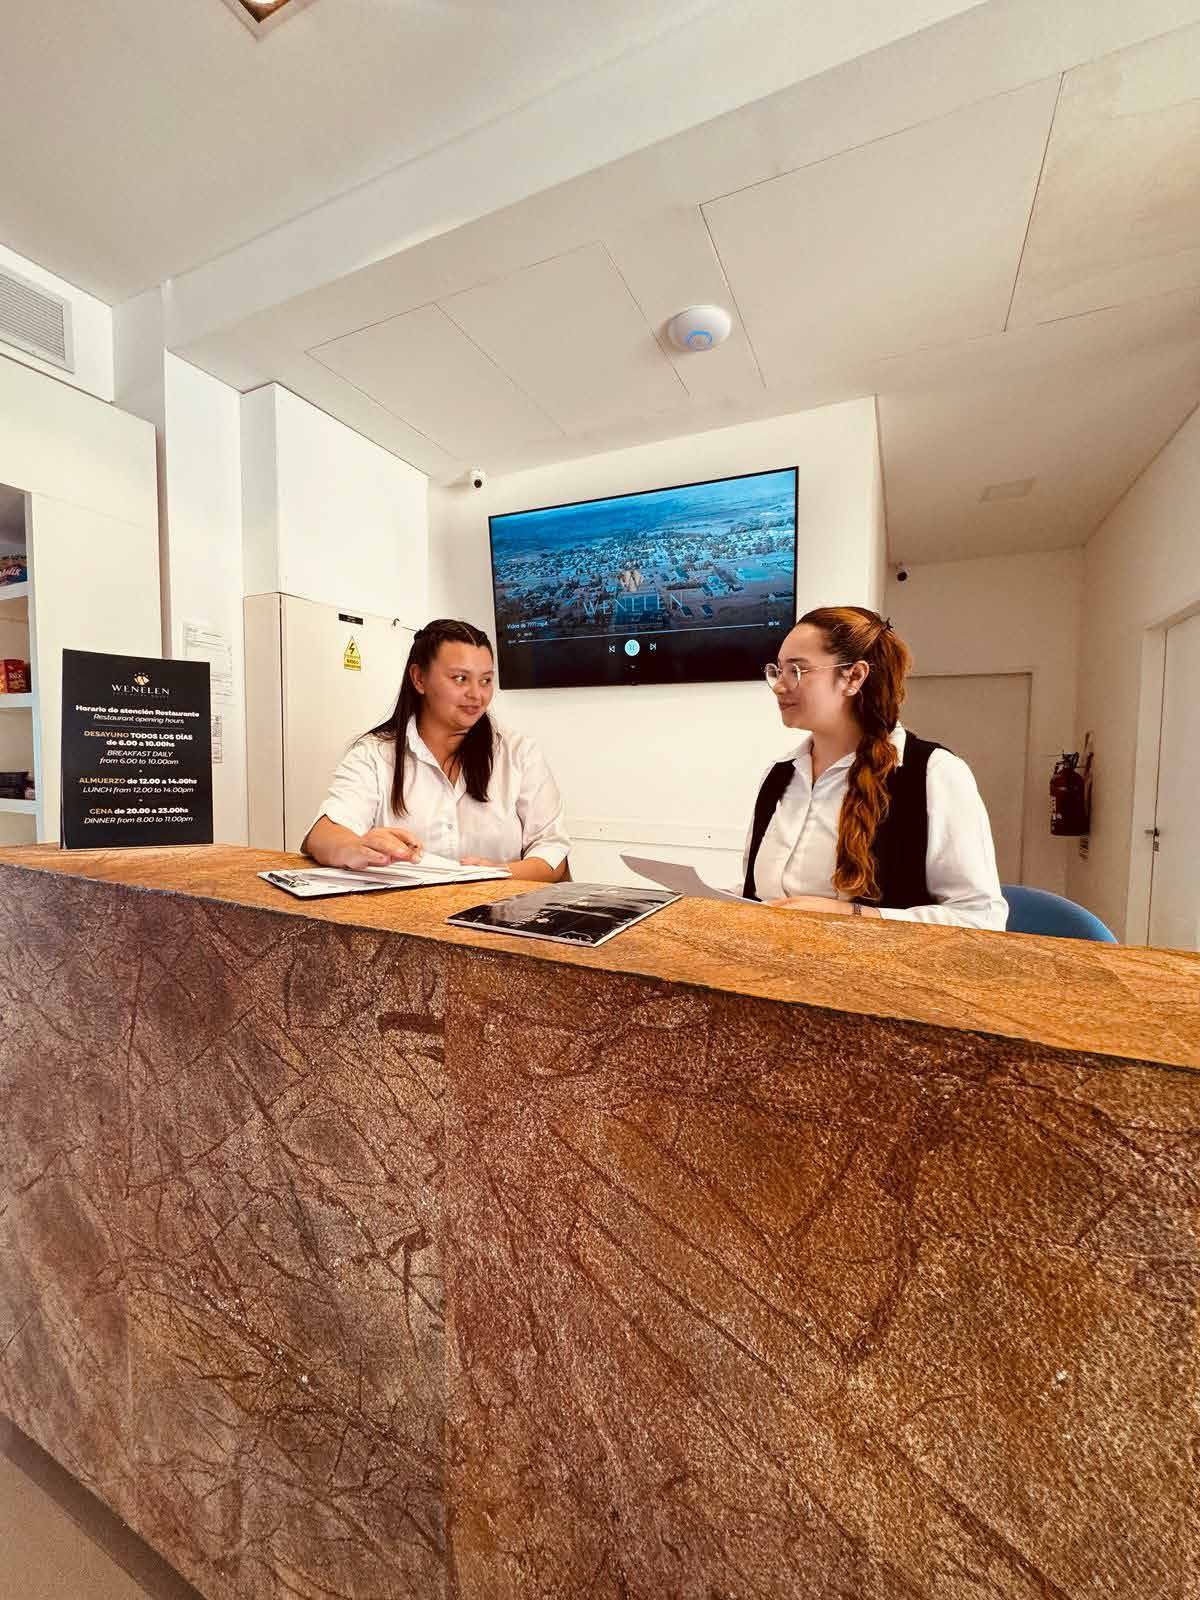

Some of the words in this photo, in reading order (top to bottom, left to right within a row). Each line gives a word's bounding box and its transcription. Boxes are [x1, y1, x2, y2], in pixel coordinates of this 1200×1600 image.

[583, 592, 684, 616] WENELEN
[111, 684, 170, 695] WENELEN
[75, 704, 107, 713] Horario
[119, 708, 154, 716] atención
[155, 709, 200, 718] Restaurante
[93, 713, 134, 722] Restaurant
[134, 715, 164, 724] opening
[83, 730, 130, 738] DESAYUNO
[130, 732, 158, 740] TODOS
[175, 732, 193, 741] DÍAS
[145, 740, 176, 748] 10.00hs
[99, 757, 119, 765] from
[112, 786, 132, 794] from
[163, 786, 194, 794] 14.00pm
[89, 807, 113, 815] CENA
[157, 806, 189, 814] 23.00hs
[83, 816, 116, 824] DINNER
[115, 816, 136, 825] from
[135, 815, 154, 823] 8.00
[155, 815, 163, 823] to
[164, 814, 193, 823] 11.00pm
